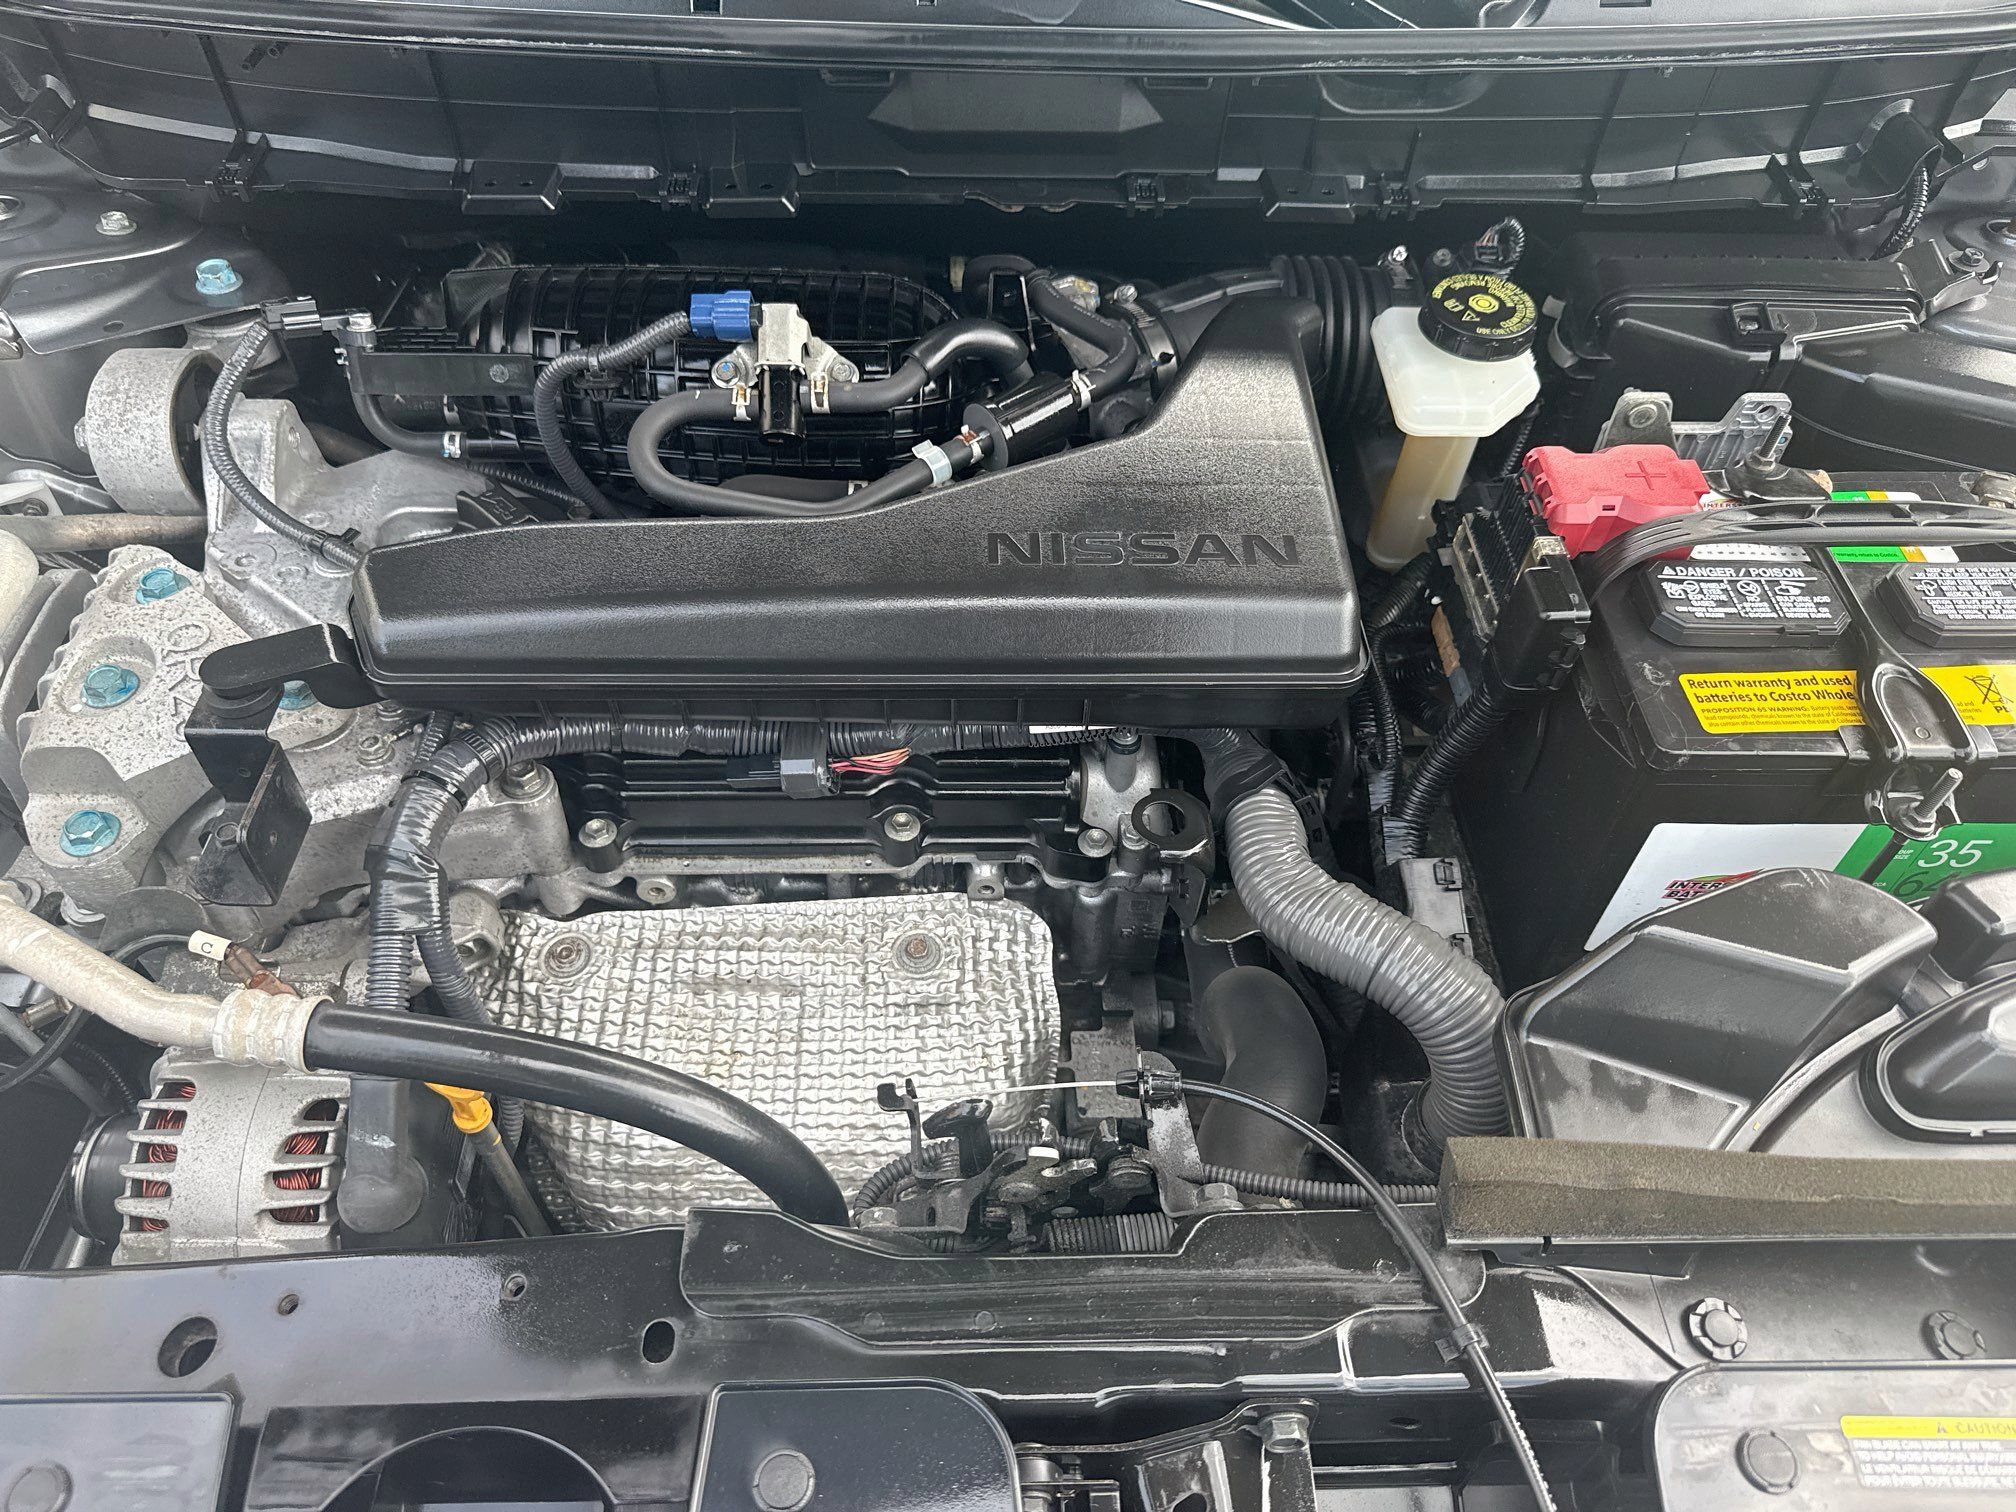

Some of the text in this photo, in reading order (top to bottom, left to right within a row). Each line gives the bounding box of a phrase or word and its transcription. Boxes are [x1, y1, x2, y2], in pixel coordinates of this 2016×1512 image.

[987, 532, 1299, 567] NISSAN
[1676, 567, 1805, 577] DANGER / POISON
[1687, 675, 1852, 690] Return warranty and used
[1693, 691, 1752, 703] batteries
[1753, 692, 1767, 702] to
[1769, 691, 1811, 702] Costco
[1918, 839, 1994, 868] 35
[201, 942, 213, 954] C
